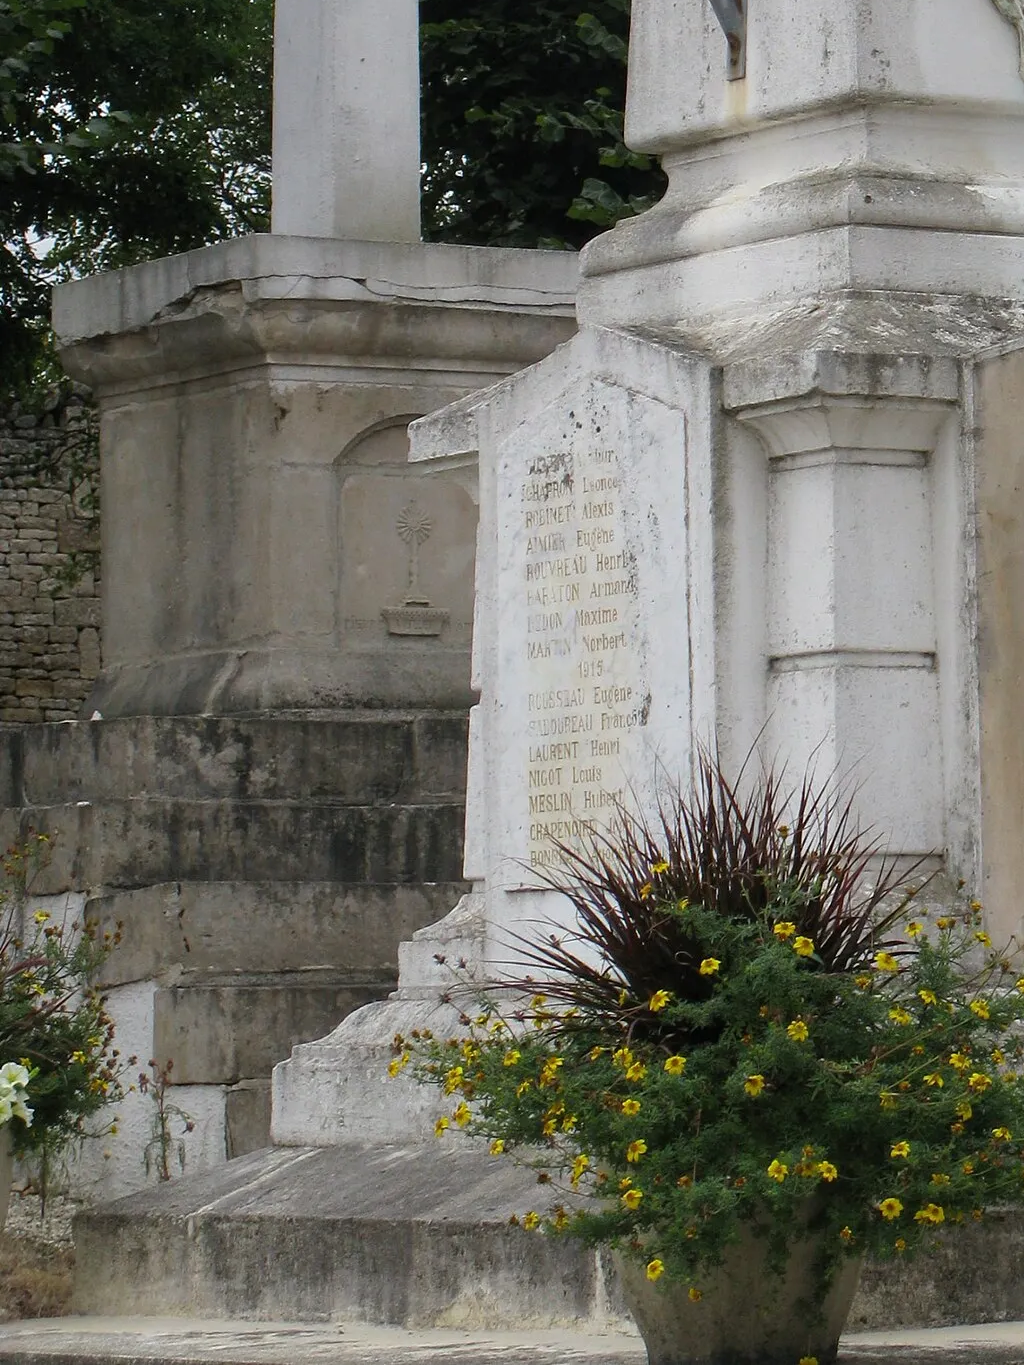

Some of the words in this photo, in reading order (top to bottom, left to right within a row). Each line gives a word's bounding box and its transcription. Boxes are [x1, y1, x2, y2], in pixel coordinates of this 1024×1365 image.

[525, 503, 572, 529] ROBINET
[581, 500, 614, 520] Alexis
[589, 575, 635, 598] Armand
[575, 607, 618, 627] Maxime
[528, 741, 579, 763] LAURENT
[591, 737, 620, 757] Henri
[572, 765, 602, 784] Louis
[528, 792, 572, 815] MESLIN
[583, 788, 624, 809] Hubert
